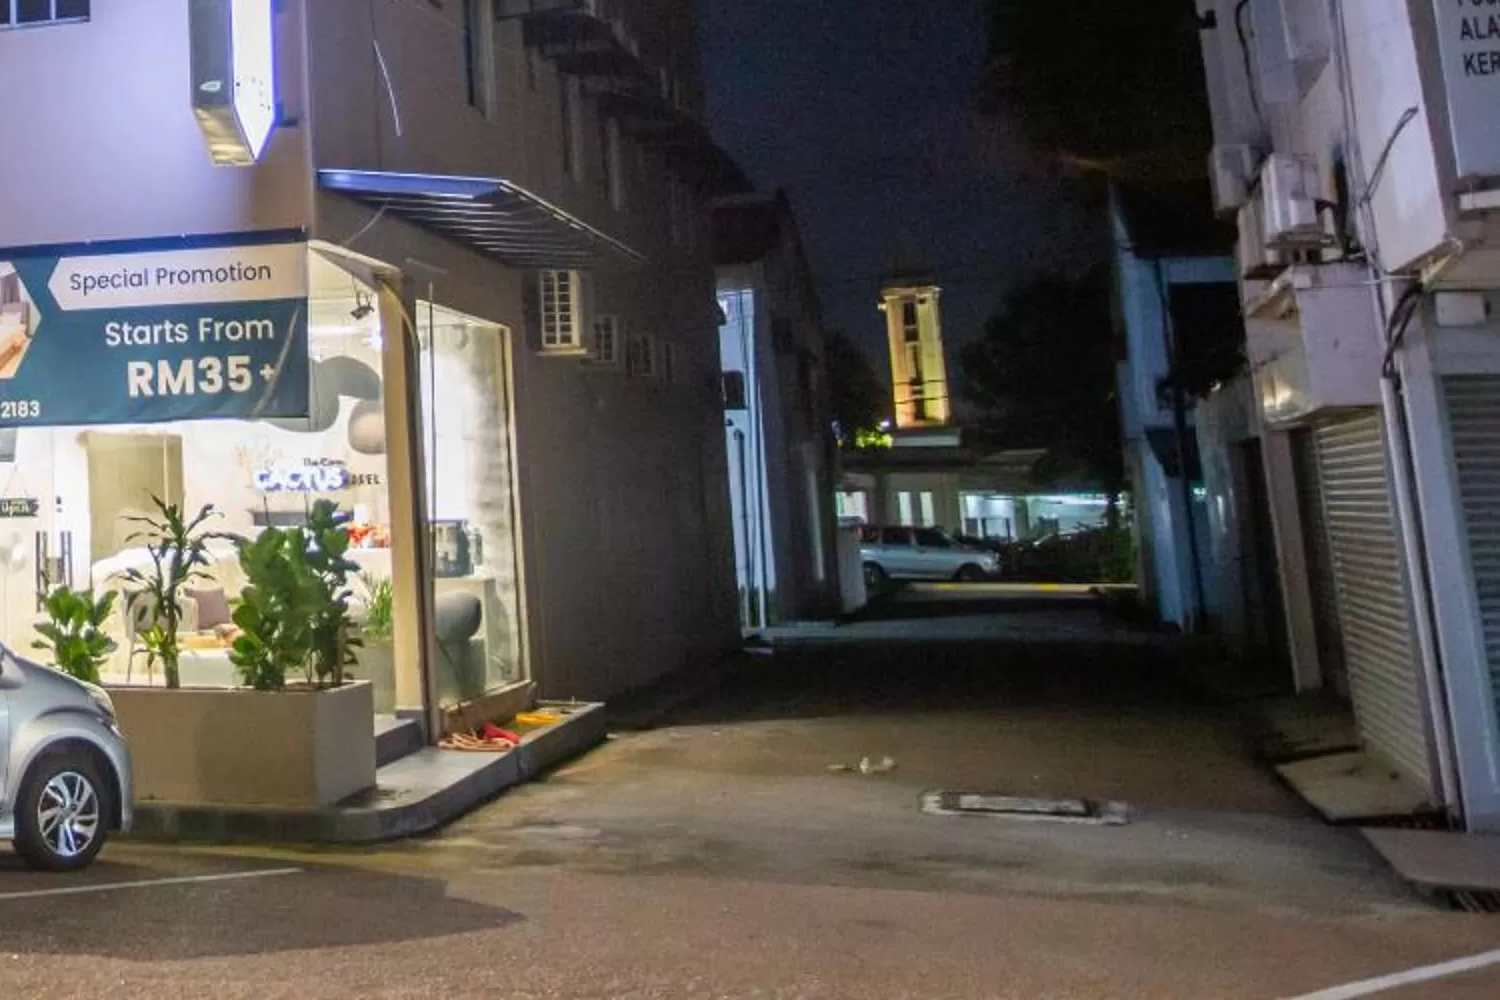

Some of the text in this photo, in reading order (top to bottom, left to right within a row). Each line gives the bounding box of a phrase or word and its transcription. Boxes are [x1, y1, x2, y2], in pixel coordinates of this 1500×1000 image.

[1460, 14, 1500, 41] ALA
[69, 261, 272, 296] Special Promotion
[105, 315, 274, 346] Starts From
[0, 400, 41, 418] 2183
